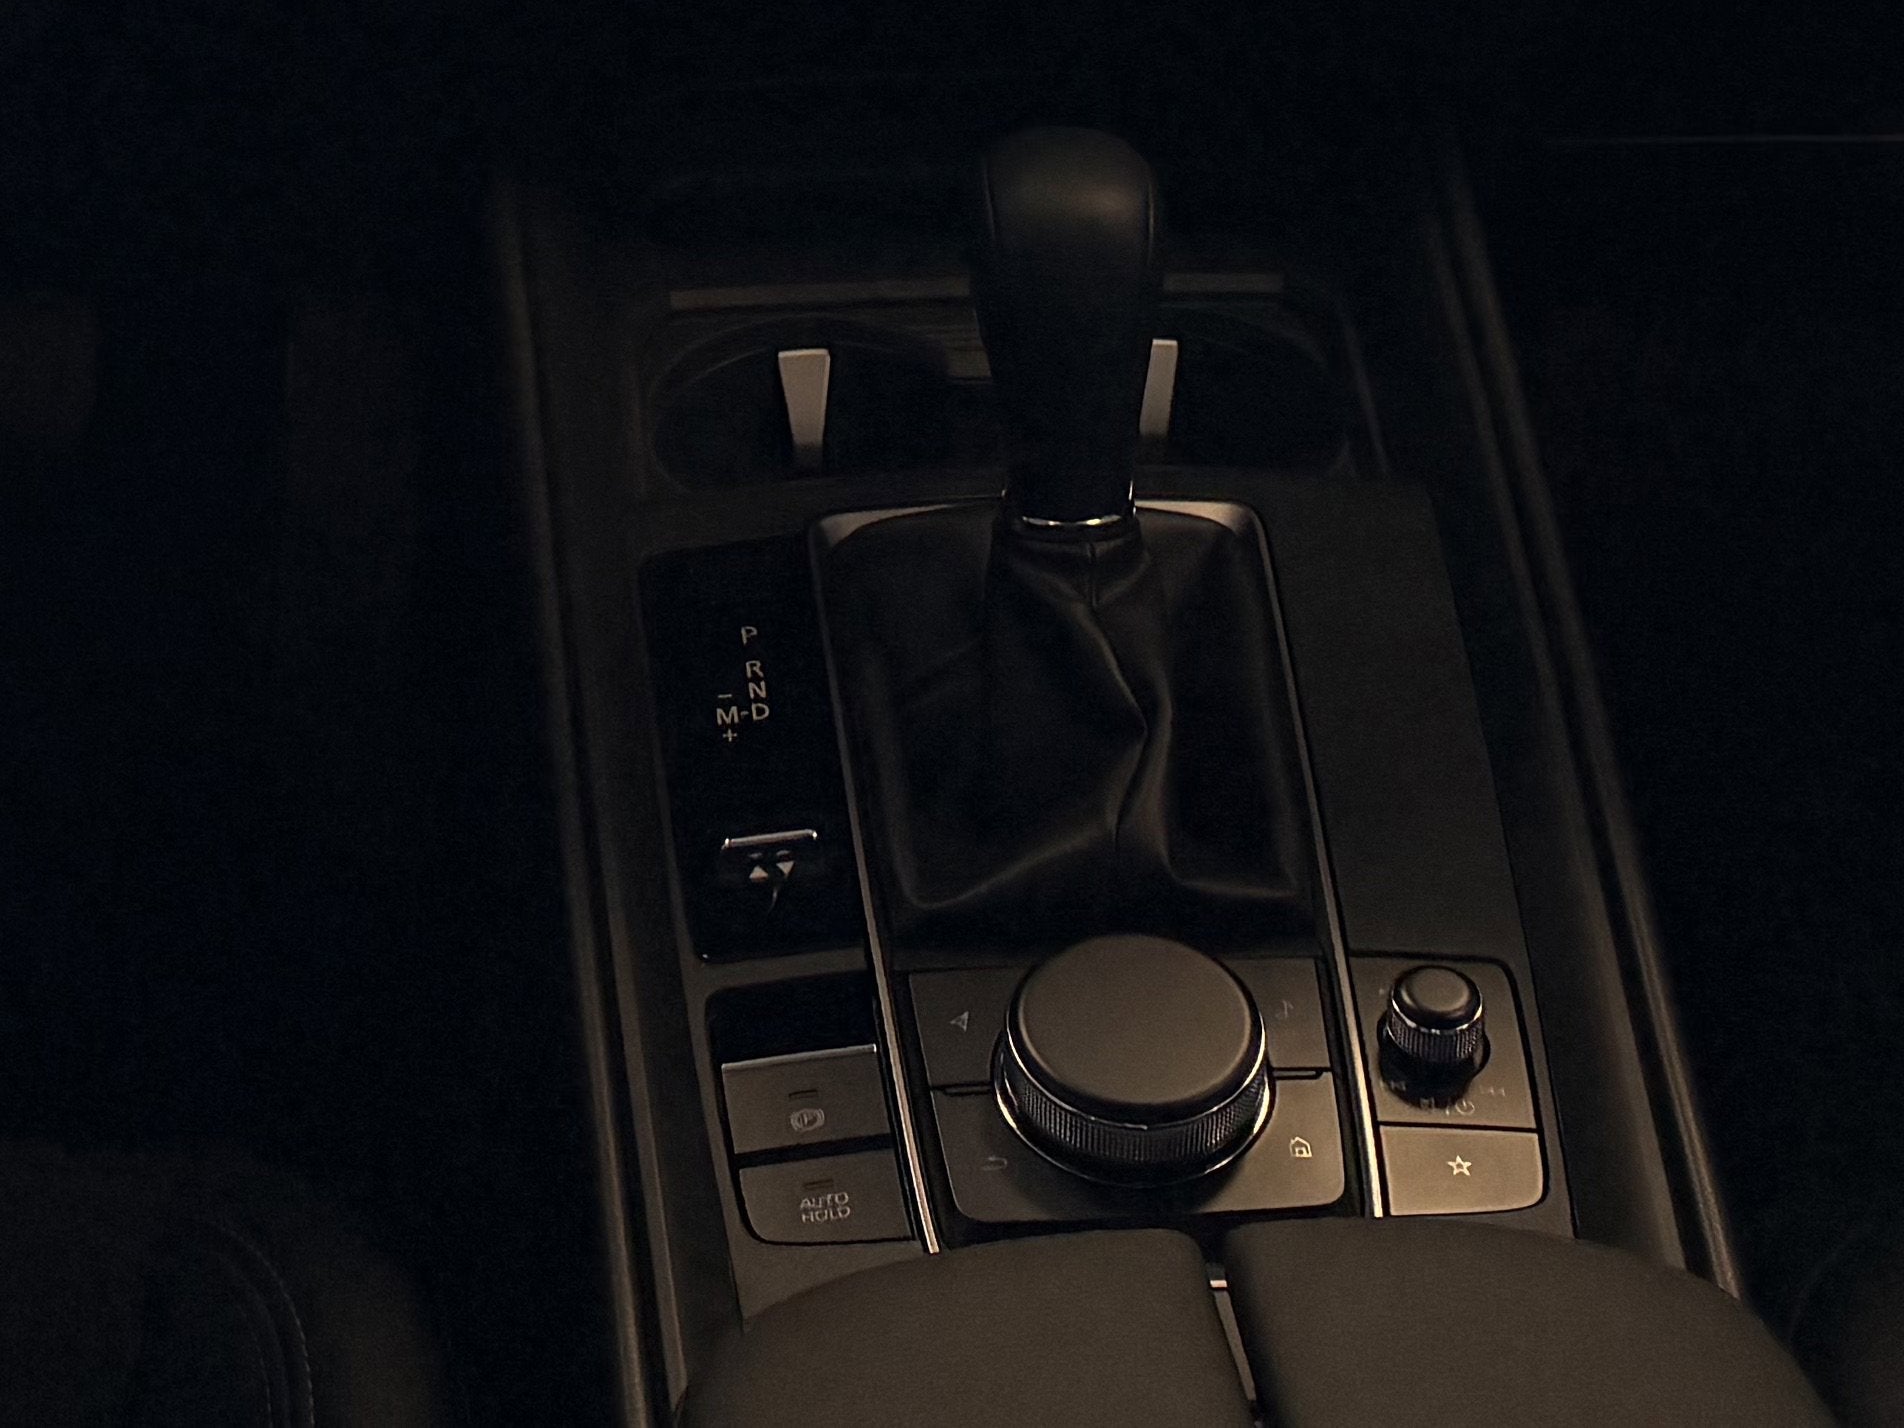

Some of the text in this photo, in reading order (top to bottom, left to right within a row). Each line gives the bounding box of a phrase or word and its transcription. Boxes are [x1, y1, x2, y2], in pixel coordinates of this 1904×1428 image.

[740, 625, 759, 646] P
[745, 659, 765, 679] R
[748, 680, 767, 700] N
[799, 1191, 850, 1209] AUTO
[801, 1205, 851, 1223] HOLD
